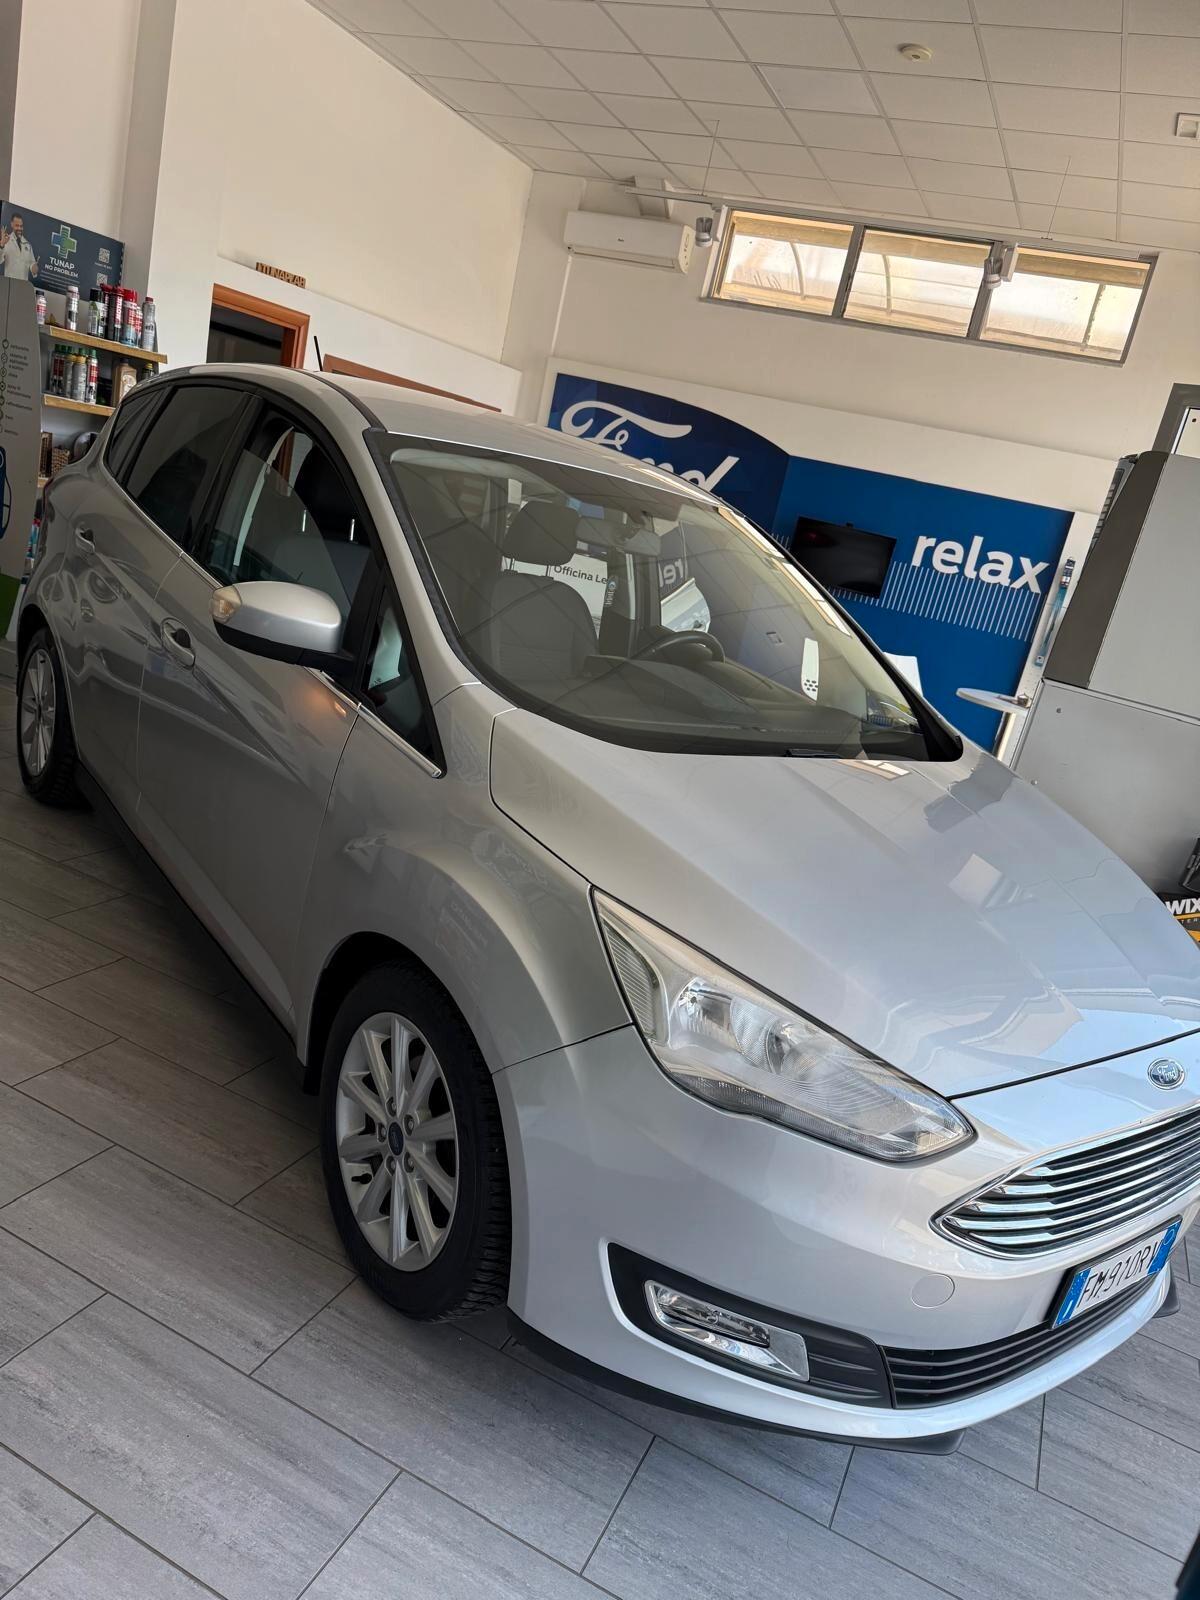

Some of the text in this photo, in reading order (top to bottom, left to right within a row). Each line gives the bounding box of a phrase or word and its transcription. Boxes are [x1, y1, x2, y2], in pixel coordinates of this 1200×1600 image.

[50, 257, 75, 270] TUNAP
[54, 266, 79, 278] PROBLEM
[911, 535, 1050, 594] relax
[554, 565, 608, 585] Officina Le
[1165, 898, 1200, 915] WIX
